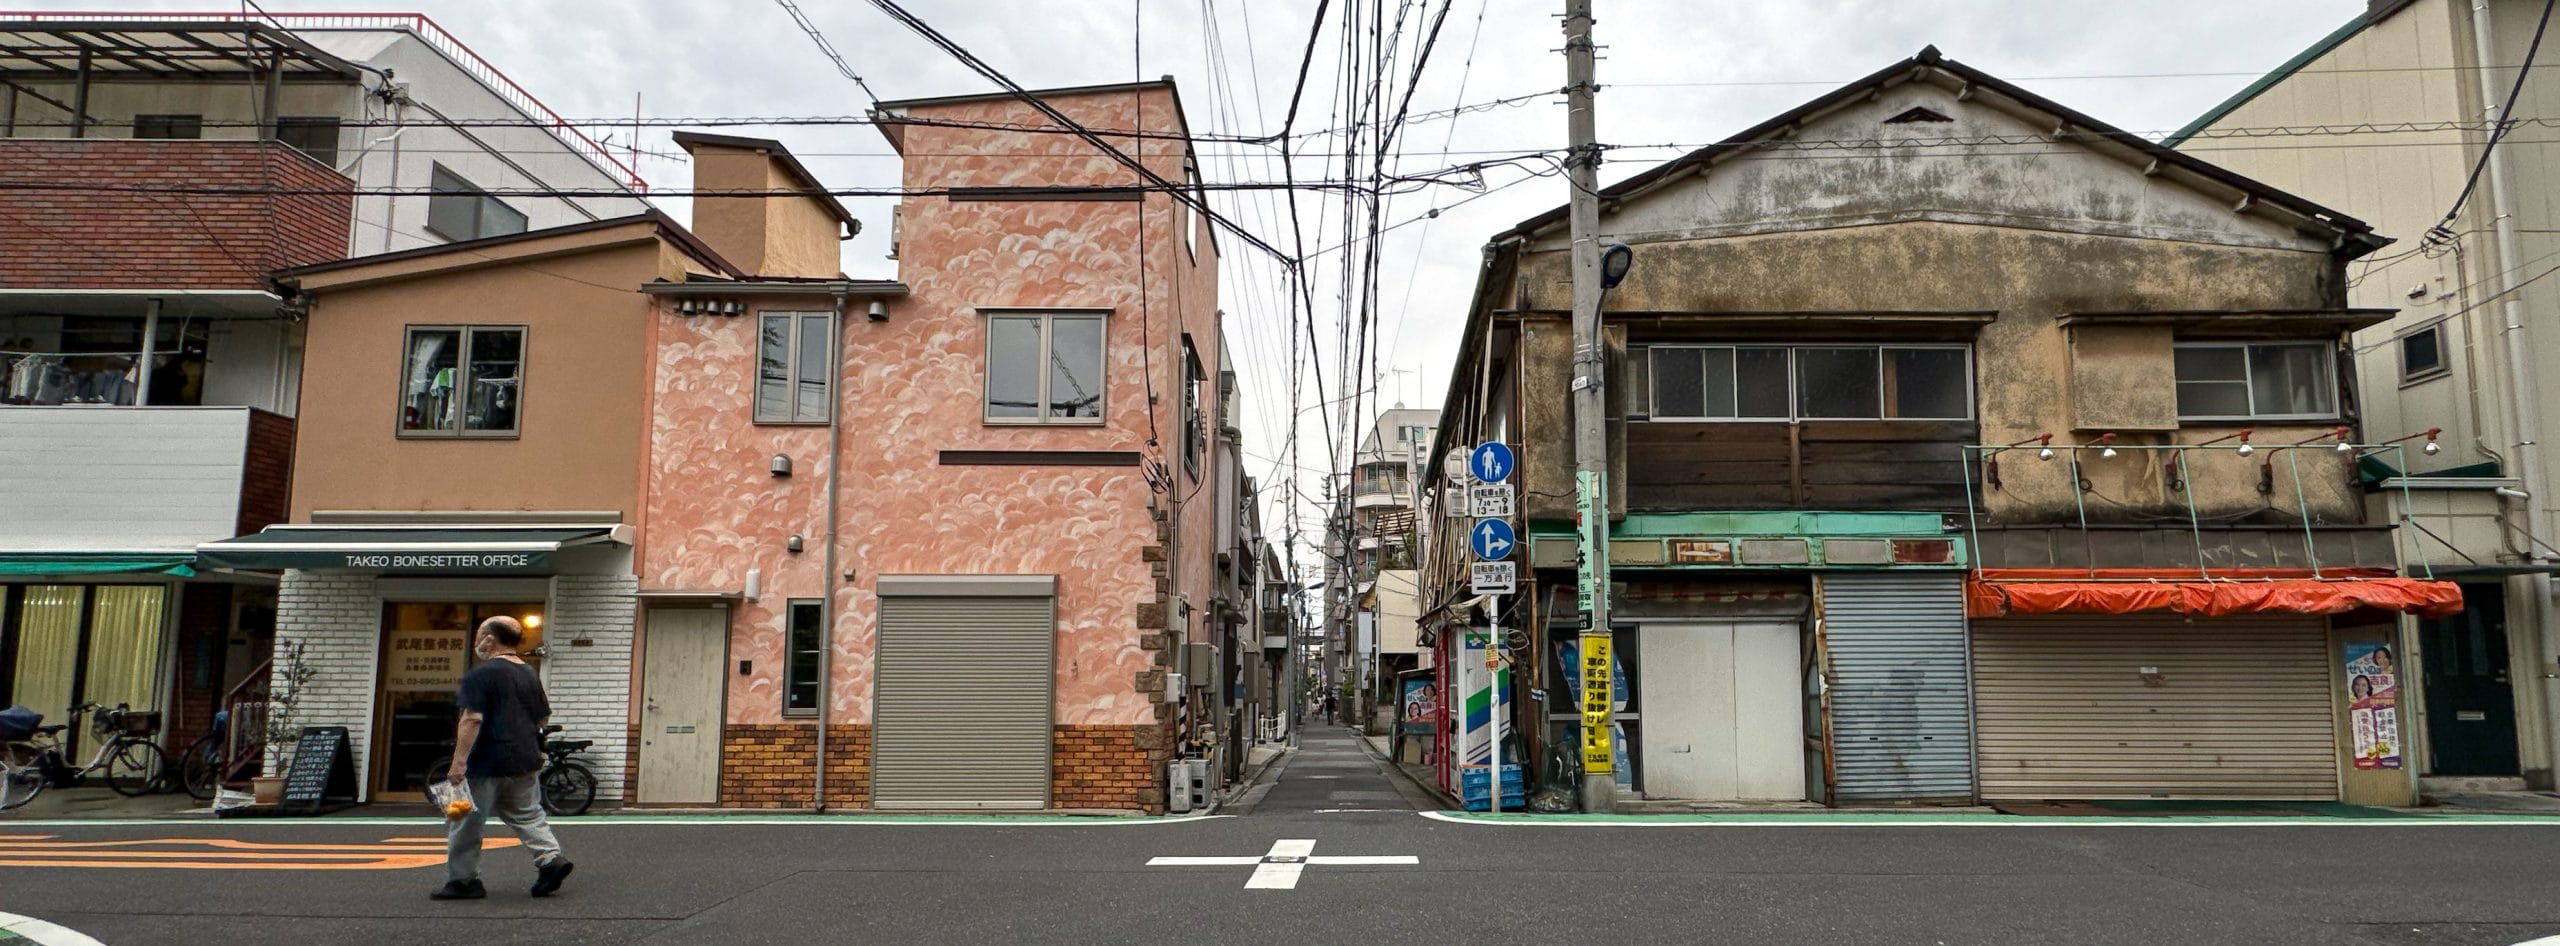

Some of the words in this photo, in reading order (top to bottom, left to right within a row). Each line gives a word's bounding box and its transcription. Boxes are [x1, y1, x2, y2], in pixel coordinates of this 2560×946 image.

[346, 555, 389, 567] TAKEO
[393, 555, 479, 567] BONESETTER
[482, 554, 528, 567] OFFICE
[1474, 573, 1512, 583] 一方通行
